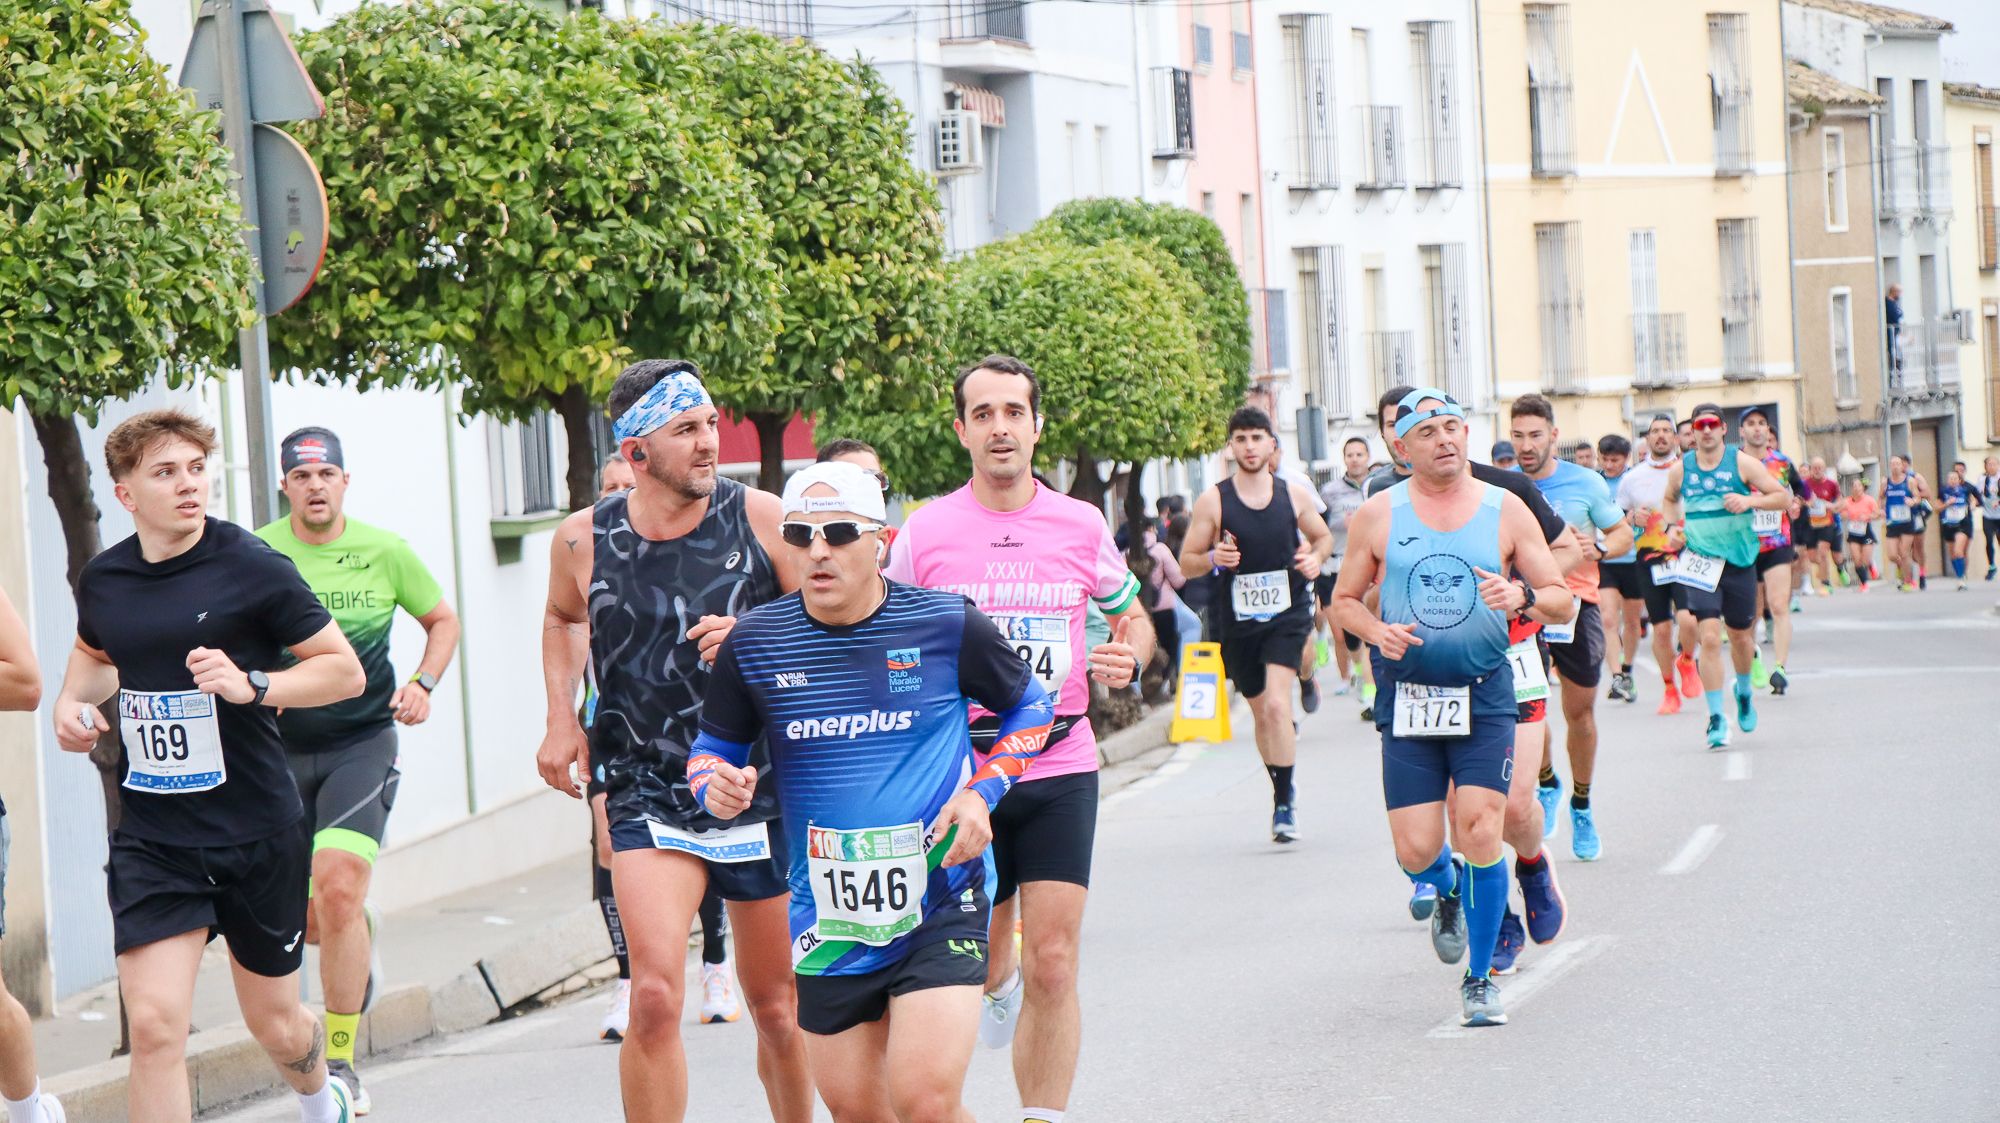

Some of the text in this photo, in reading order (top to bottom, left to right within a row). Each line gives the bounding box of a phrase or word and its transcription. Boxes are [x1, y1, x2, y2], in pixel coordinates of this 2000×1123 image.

[984, 561, 1034, 579] XXXVI
[1686, 557, 1711, 577] 292
[1242, 588, 1281, 607] 1202
[1427, 595, 1456, 604] CICLOS
[1422, 608, 1462, 616] MORENO
[788, 672, 805, 681] RUN
[791, 679, 808, 687] PRO
[888, 670, 908, 679] Club
[890, 684, 921, 693] Lucena
[1190, 689, 1205, 709] 2
[1404, 700, 1462, 729] 1172
[786, 709, 913, 740] enerplus
[137, 724, 189, 762] 169
[813, 831, 846, 861] 10K
[823, 867, 908, 912] 1546
